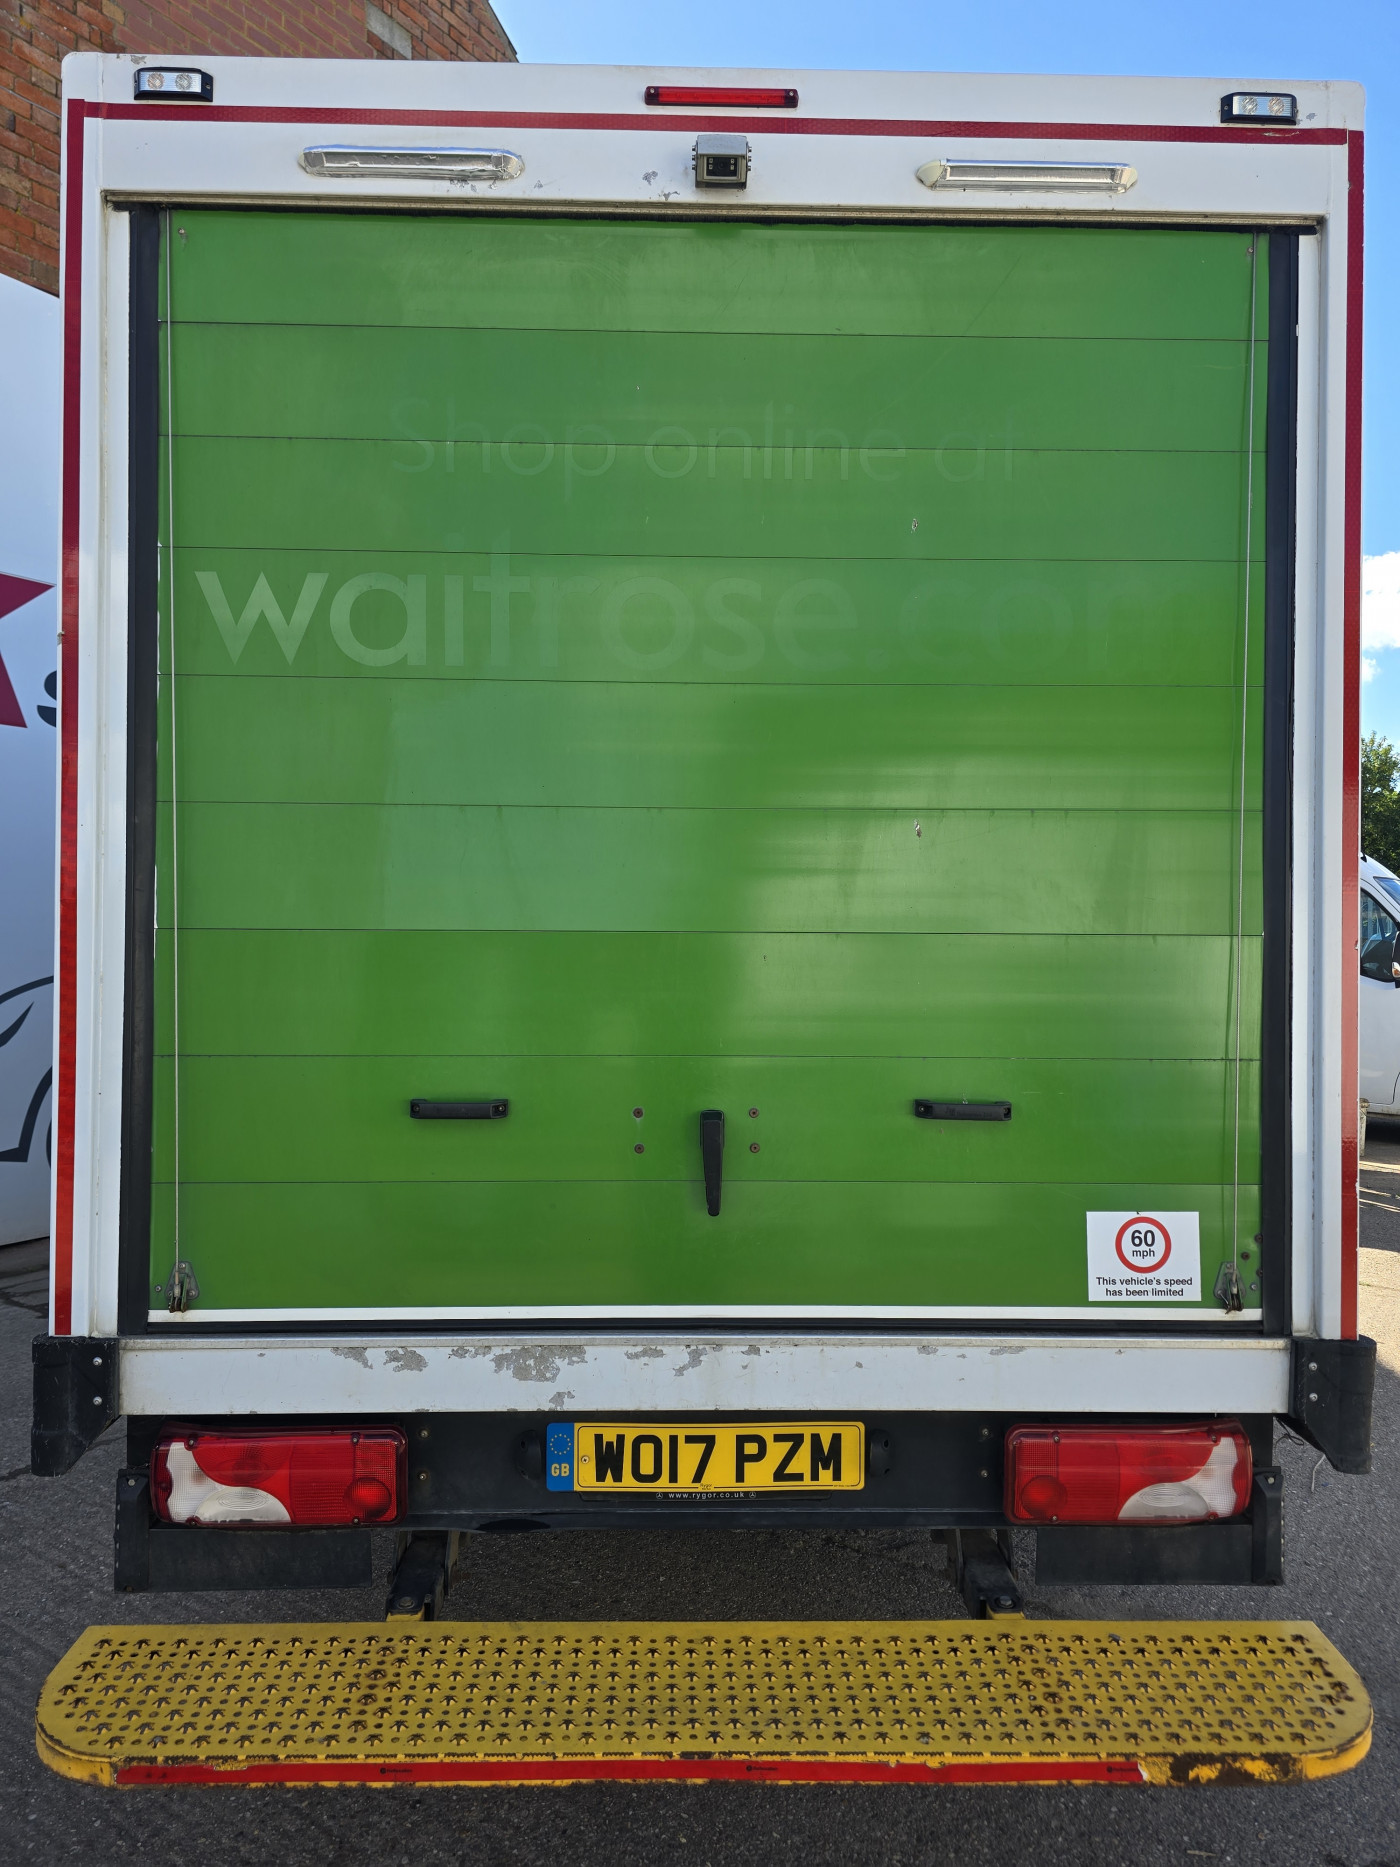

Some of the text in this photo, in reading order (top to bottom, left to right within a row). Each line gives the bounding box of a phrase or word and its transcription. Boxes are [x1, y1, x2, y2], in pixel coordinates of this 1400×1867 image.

[390, 393, 617, 503] Shop
[644, 399, 906, 482] online
[1131, 1229, 1155, 1247] 60
[1132, 1248, 1155, 1259] mph
[1096, 1276, 1193, 1288] This vehicle's speed
[1105, 1287, 1184, 1297] has been limited
[594, 1432, 842, 1484] WO17 PZM
[551, 1463, 570, 1477] GB
[668, 1491, 745, 1500] www.rygor.co.uk
